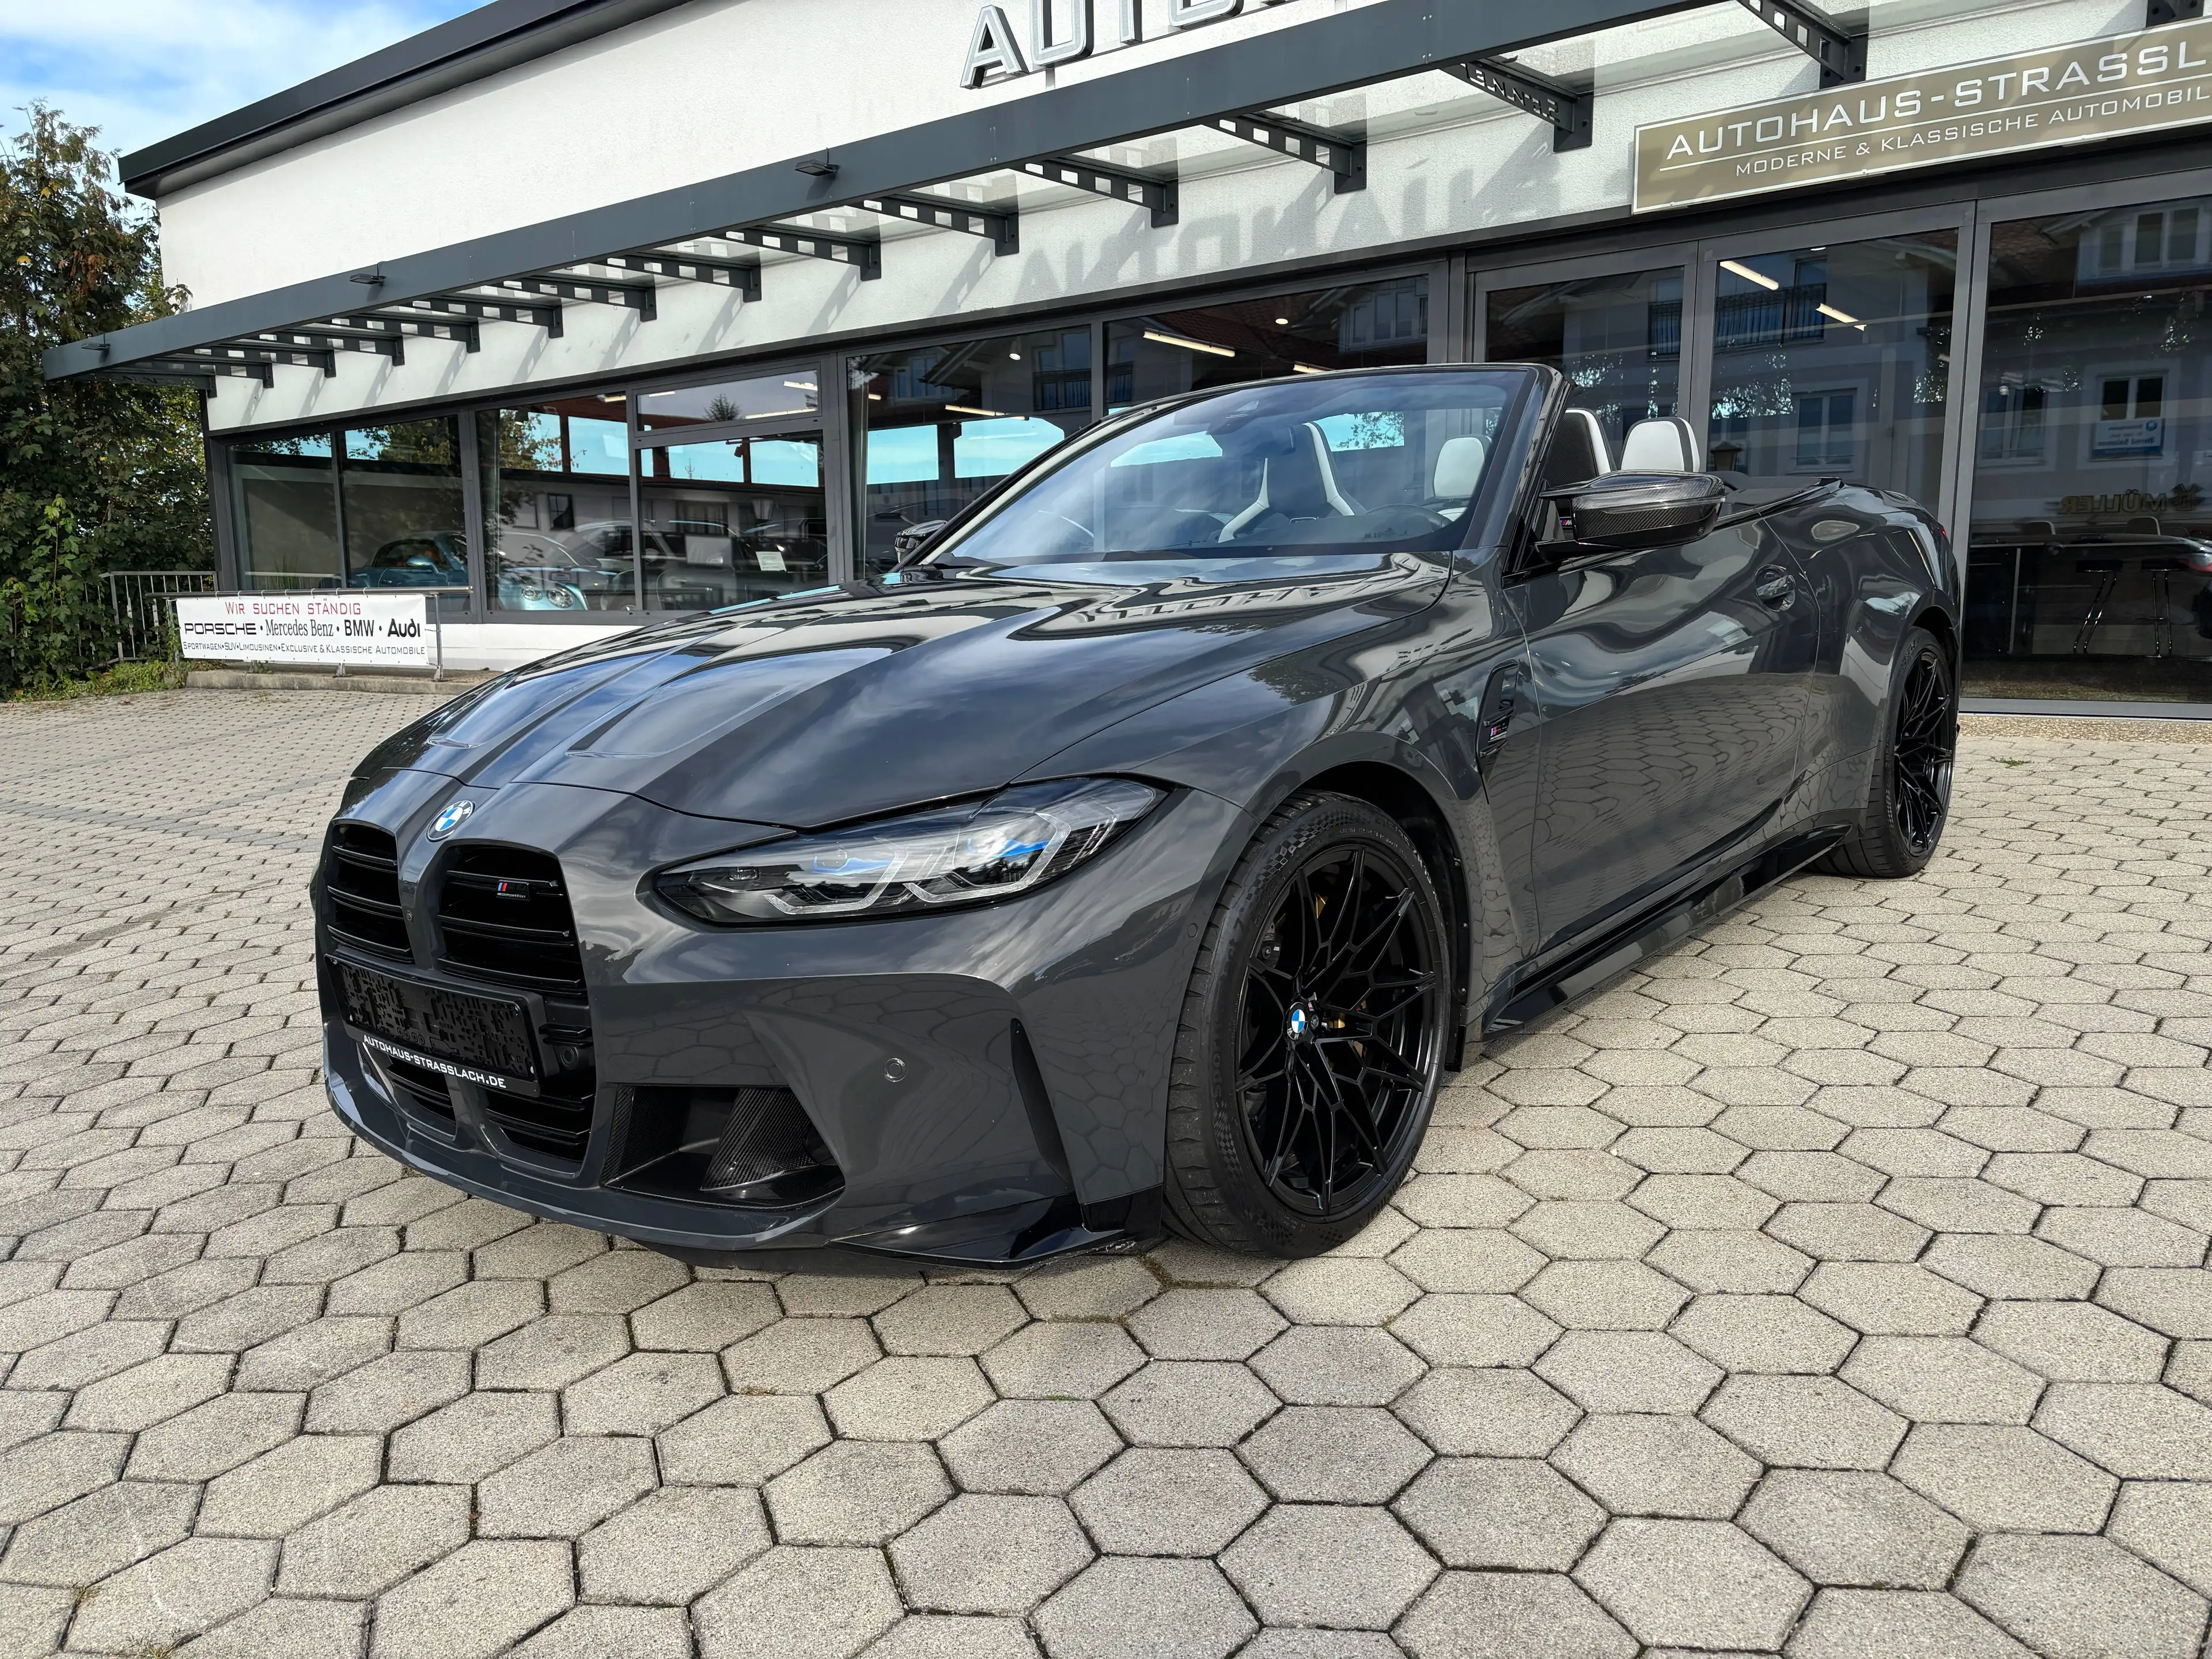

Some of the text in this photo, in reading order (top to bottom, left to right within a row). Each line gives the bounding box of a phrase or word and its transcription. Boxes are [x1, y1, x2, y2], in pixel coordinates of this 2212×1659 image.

[1666, 41, 2207, 161] AUTOHAUS-STRASSL
[1735, 85, 2210, 177] MODERNE & KLASSISCHE AUTOMOBIL
[253, 603, 300, 615] SUCHEN
[308, 598, 361, 615] STÄNDIG
[184, 618, 421, 638] PORSCHE Mercedes Benz BMW Audi
[319, 644, 325, 653] &
[363, 1034, 507, 1089] AUTOHAUS-STRASSLACH.DE
